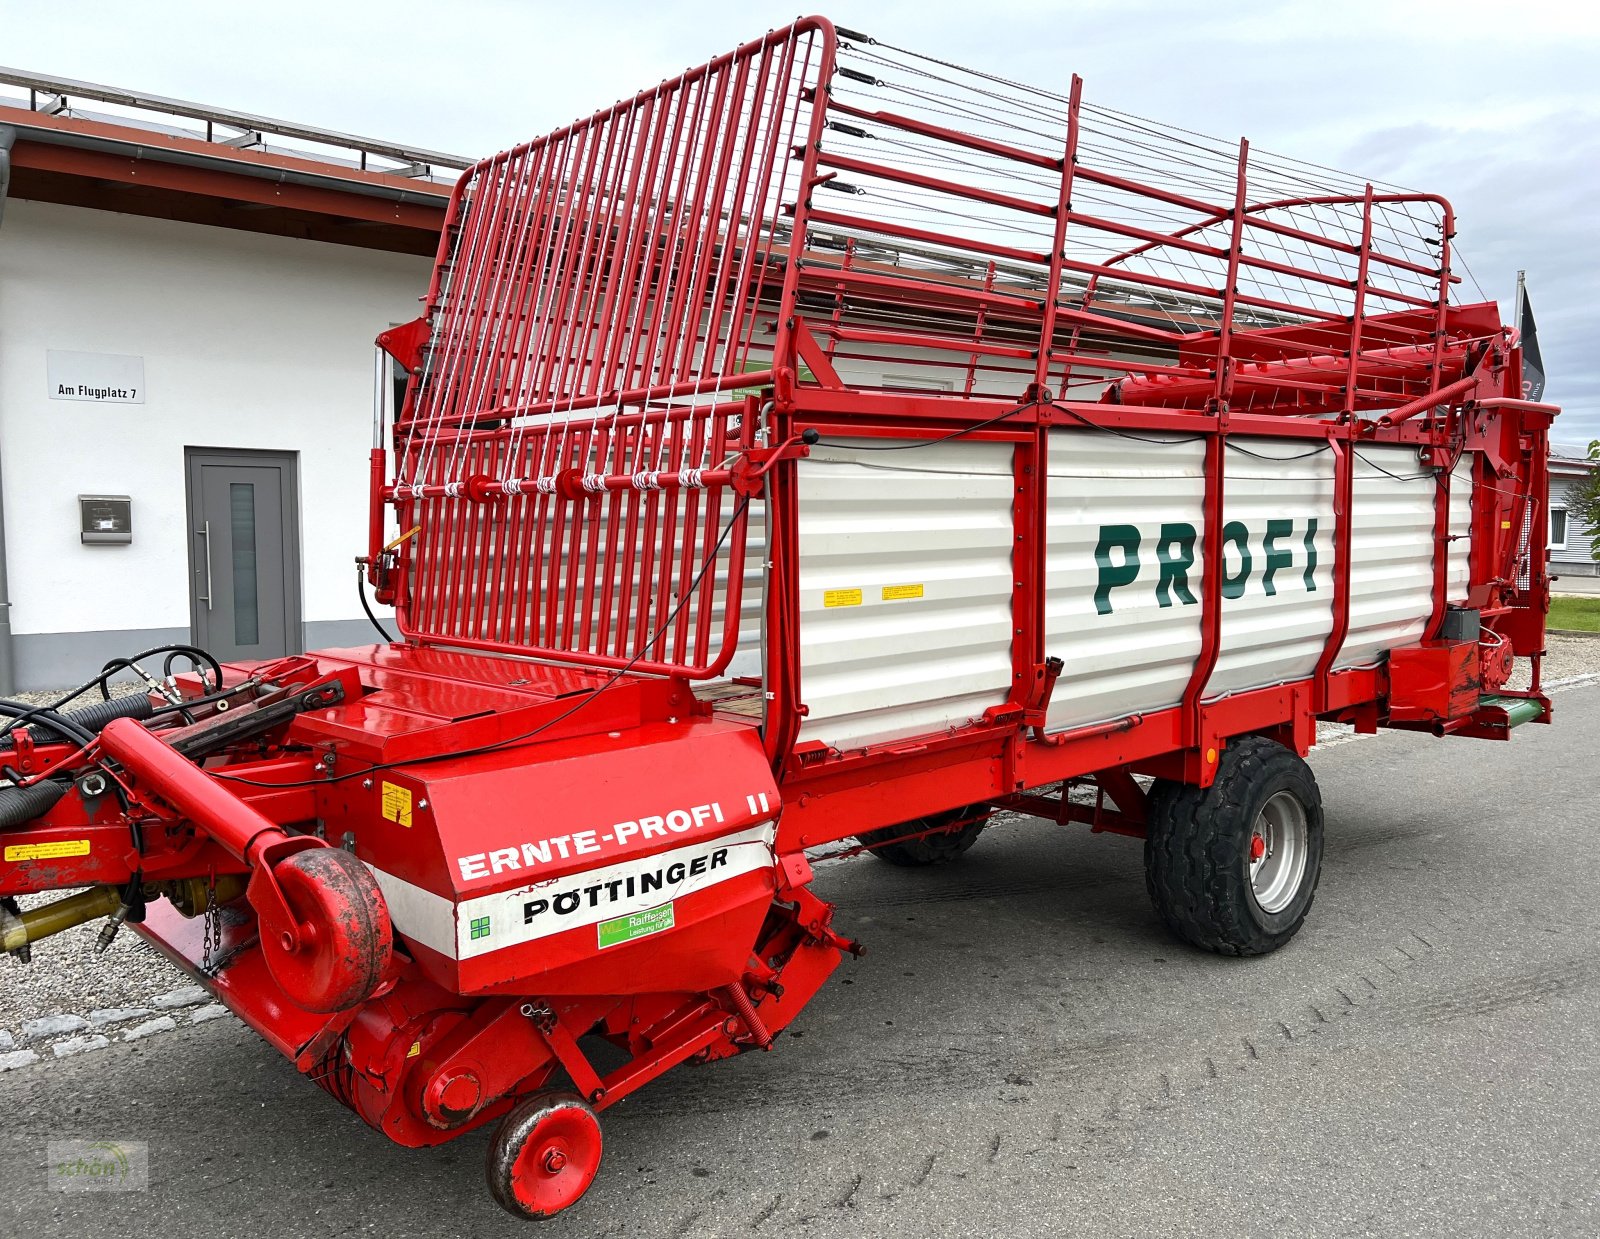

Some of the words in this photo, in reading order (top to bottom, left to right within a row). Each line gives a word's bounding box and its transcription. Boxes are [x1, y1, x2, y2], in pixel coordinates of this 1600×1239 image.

[58, 384, 75, 395] Am
[78, 385, 128, 399] Flugplatz
[130, 389, 137, 399] 7
[1094, 518, 1318, 615] PROFI
[457, 802, 725, 881] ERNTE-PROFI
[523, 848, 729, 924] PÖTTINGER
[629, 908, 672, 927] Raiffeisen
[629, 924, 655, 936] Leistung
